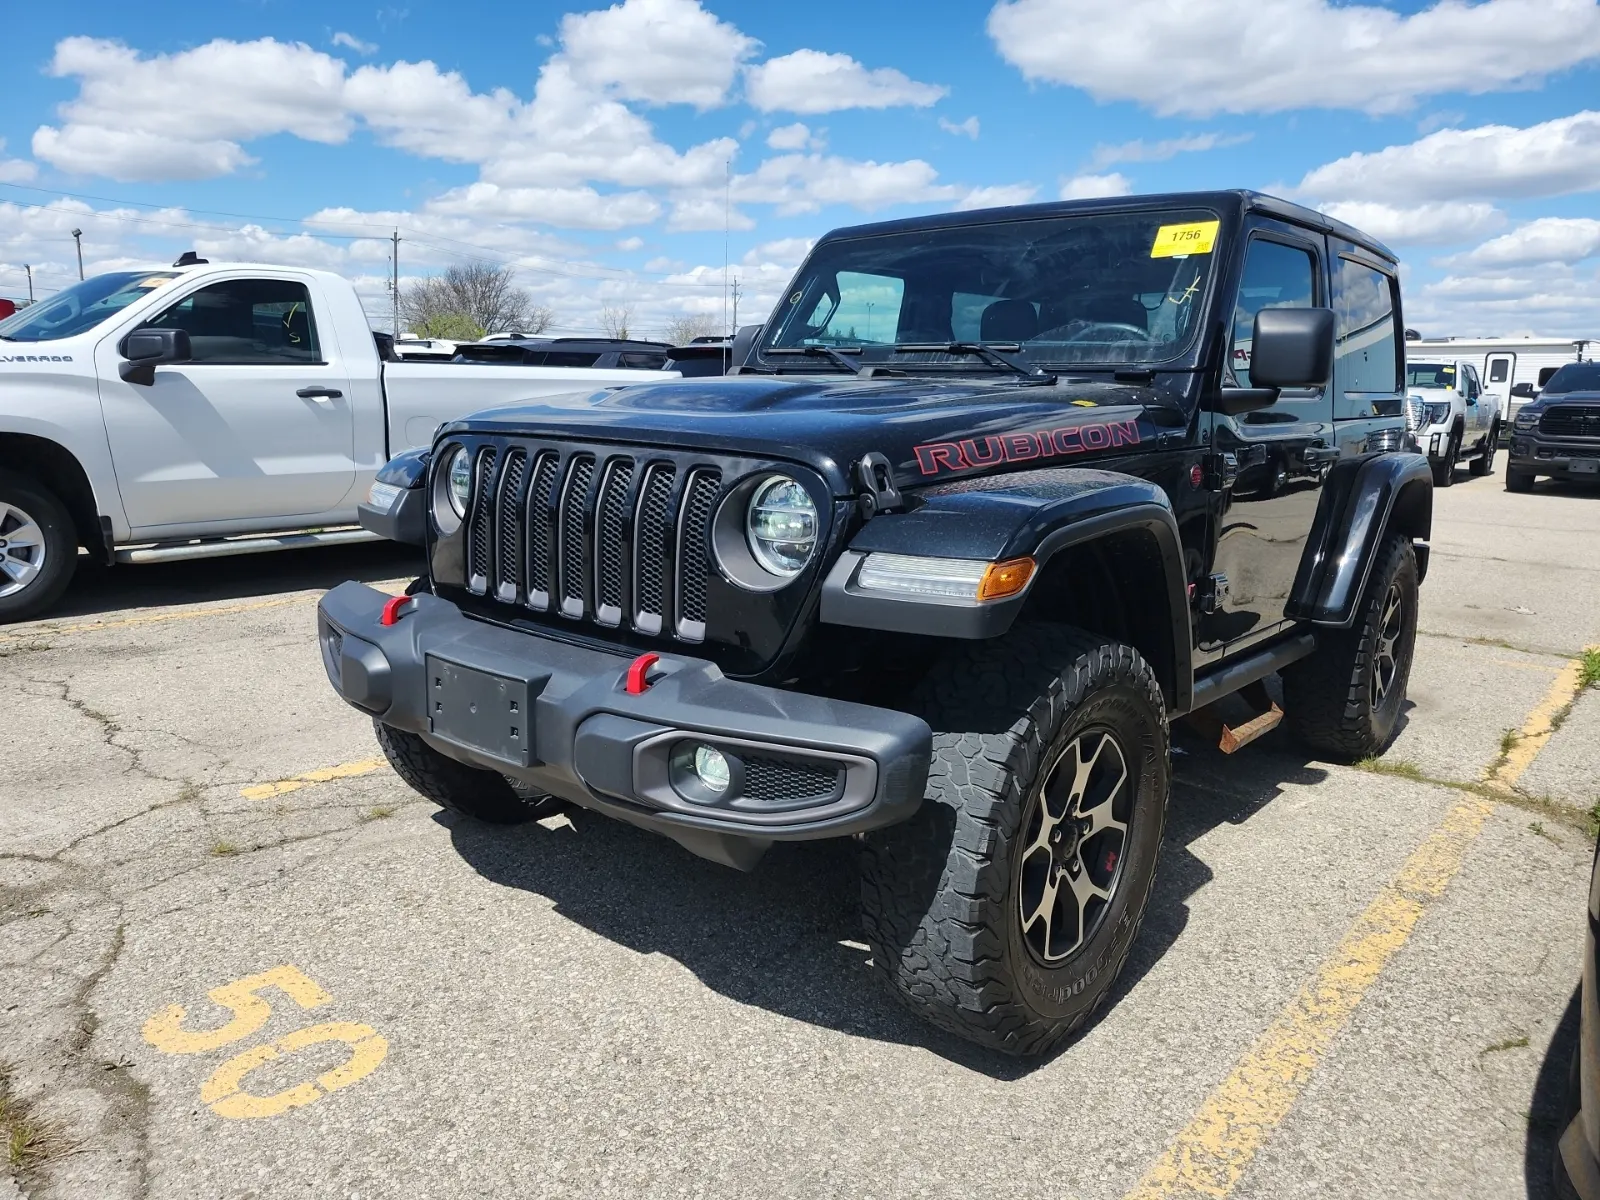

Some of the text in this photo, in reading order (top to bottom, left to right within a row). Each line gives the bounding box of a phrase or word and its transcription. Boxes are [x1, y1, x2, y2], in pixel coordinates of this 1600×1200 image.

[1172, 230, 1202, 242] 1756
[913, 420, 1140, 475] RUBICON
[140, 964, 390, 1120] 50
